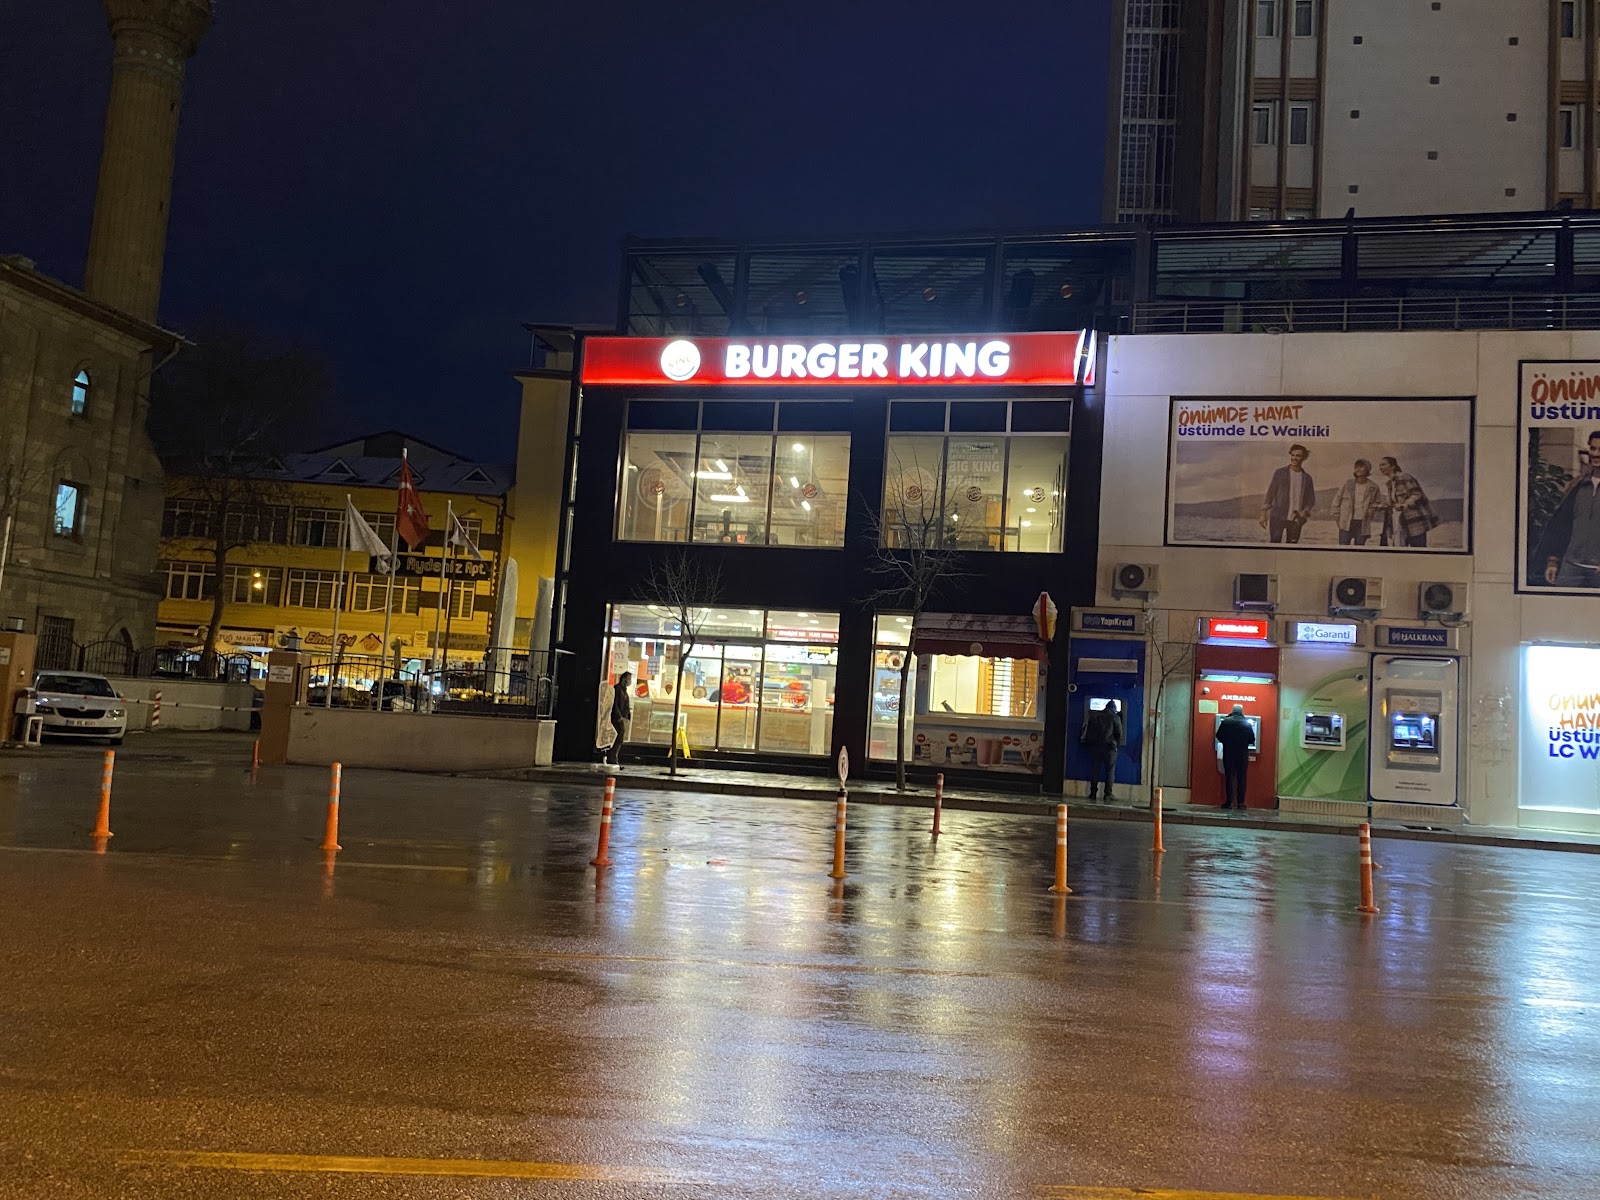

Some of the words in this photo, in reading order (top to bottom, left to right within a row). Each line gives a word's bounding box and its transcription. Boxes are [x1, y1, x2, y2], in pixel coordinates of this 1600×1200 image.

[724, 343, 889, 378] BURGER
[899, 340, 1011, 378] KING
[1253, 405, 1303, 422] HAYAT
[1178, 424, 1246, 436] üstümde
[1250, 425, 1269, 436] LC
[1272, 425, 1330, 437] Waikiki
[406, 557, 463, 575] Aydeniz
[1315, 629, 1350, 640] Garanti
[1401, 633, 1445, 642] HALKBANK
[1221, 694, 1256, 702] AKBANK
[1549, 743, 1575, 759] LC
